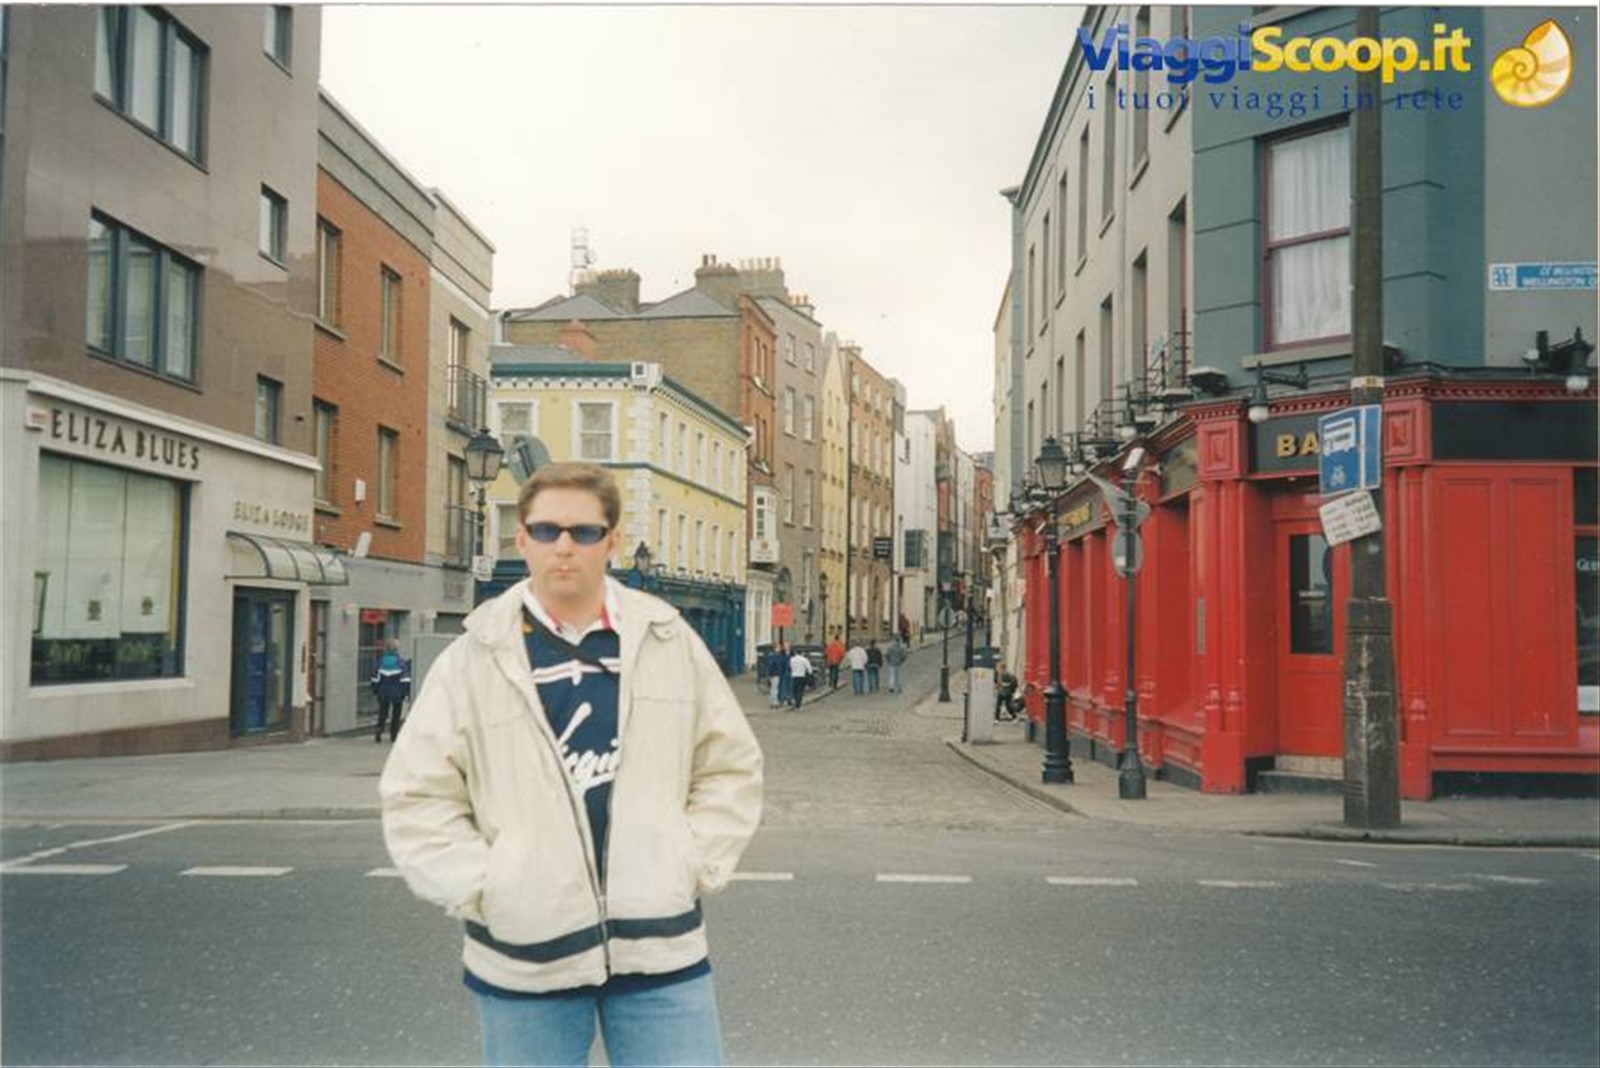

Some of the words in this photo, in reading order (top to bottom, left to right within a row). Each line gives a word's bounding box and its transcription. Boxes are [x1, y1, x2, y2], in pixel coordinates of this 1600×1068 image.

[51, 408, 127, 455] ELIZA
[135, 428, 201, 472] BLUES
[1276, 431, 1320, 457] BA
